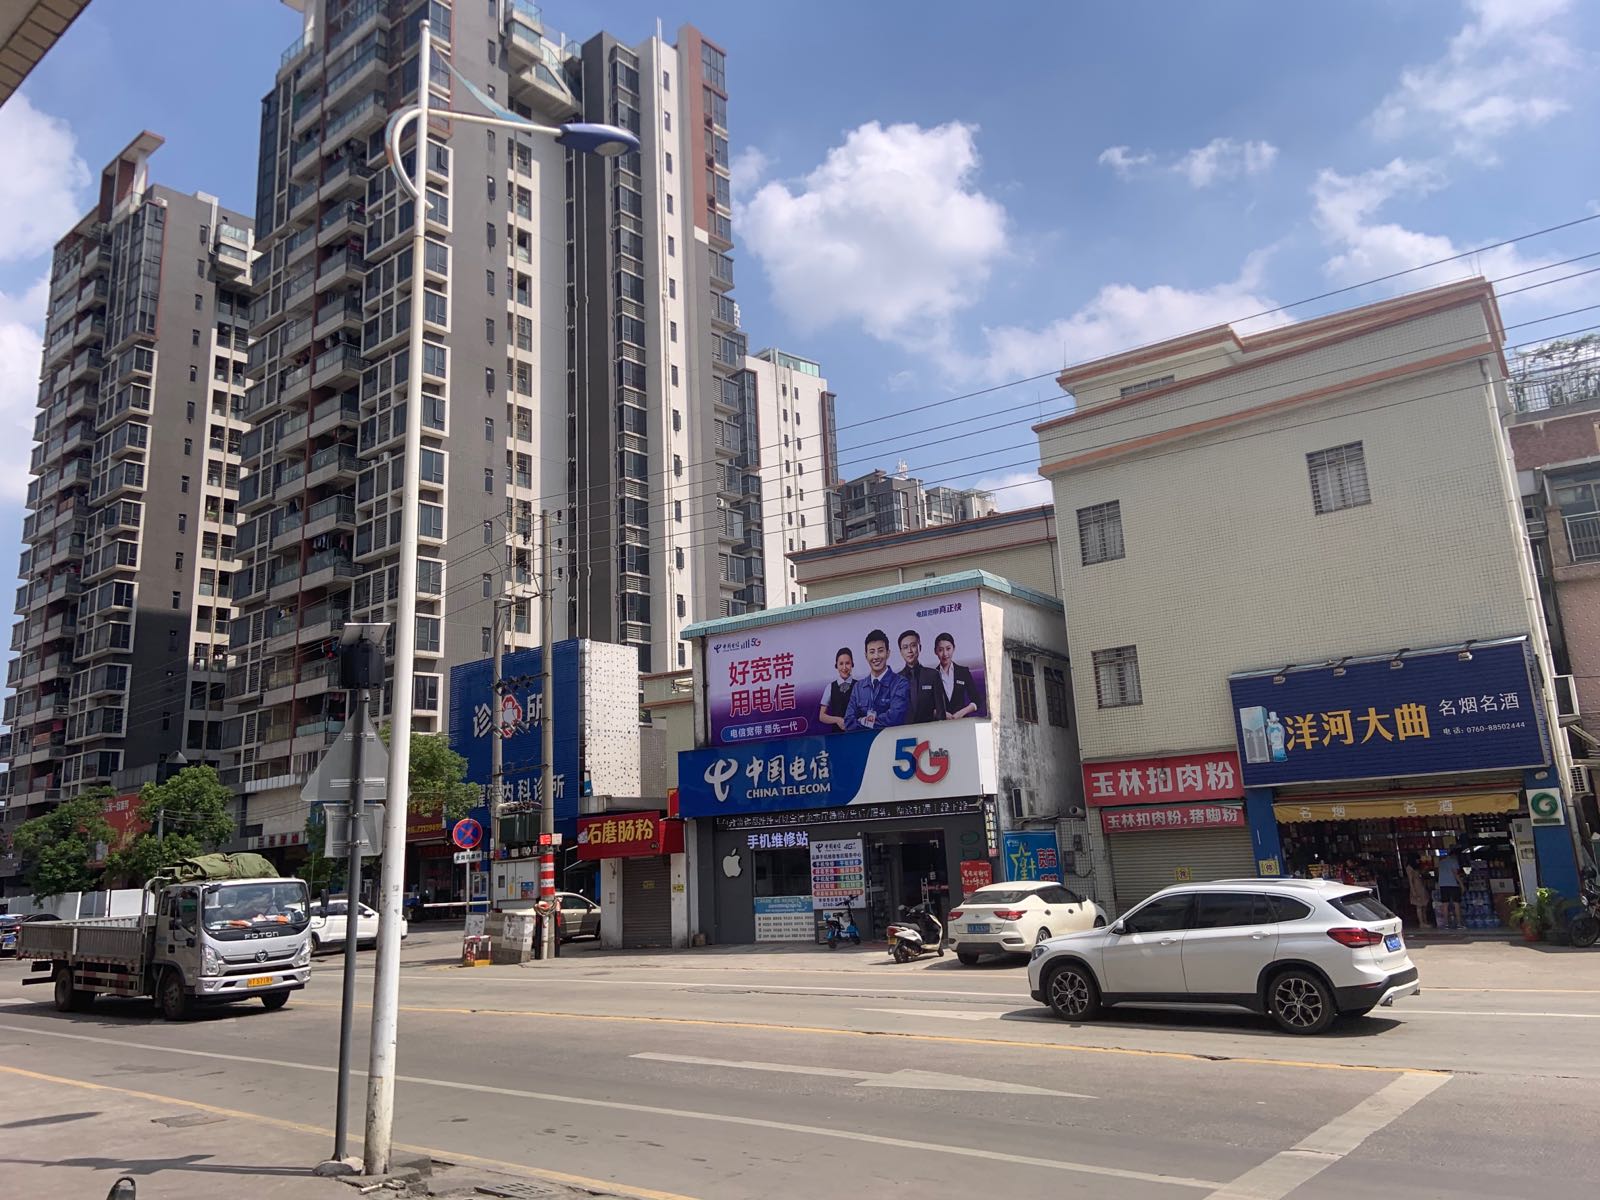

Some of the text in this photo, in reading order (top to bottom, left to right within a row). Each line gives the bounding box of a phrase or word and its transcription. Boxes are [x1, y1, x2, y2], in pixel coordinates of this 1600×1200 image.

[729, 652, 794, 687] 好宽带
[729, 682, 796, 718] 用电信
[1438, 692, 1520, 717] 名烟名酒
[730, 721, 798, 738] 电信宽带 领先一代
[1285, 703, 1431, 751] 洋河大曲
[746, 750, 831, 788] 中国电信
[893, 737, 949, 784] 5G
[746, 782, 831, 799] CHINA TELECOM
[1091, 761, 1235, 797] 玉林扣肉粉
[588, 819, 655, 845] 石磨肠粉
[747, 831, 809, 849] 手机维修站
[244, 931, 279, 940] FOTON
